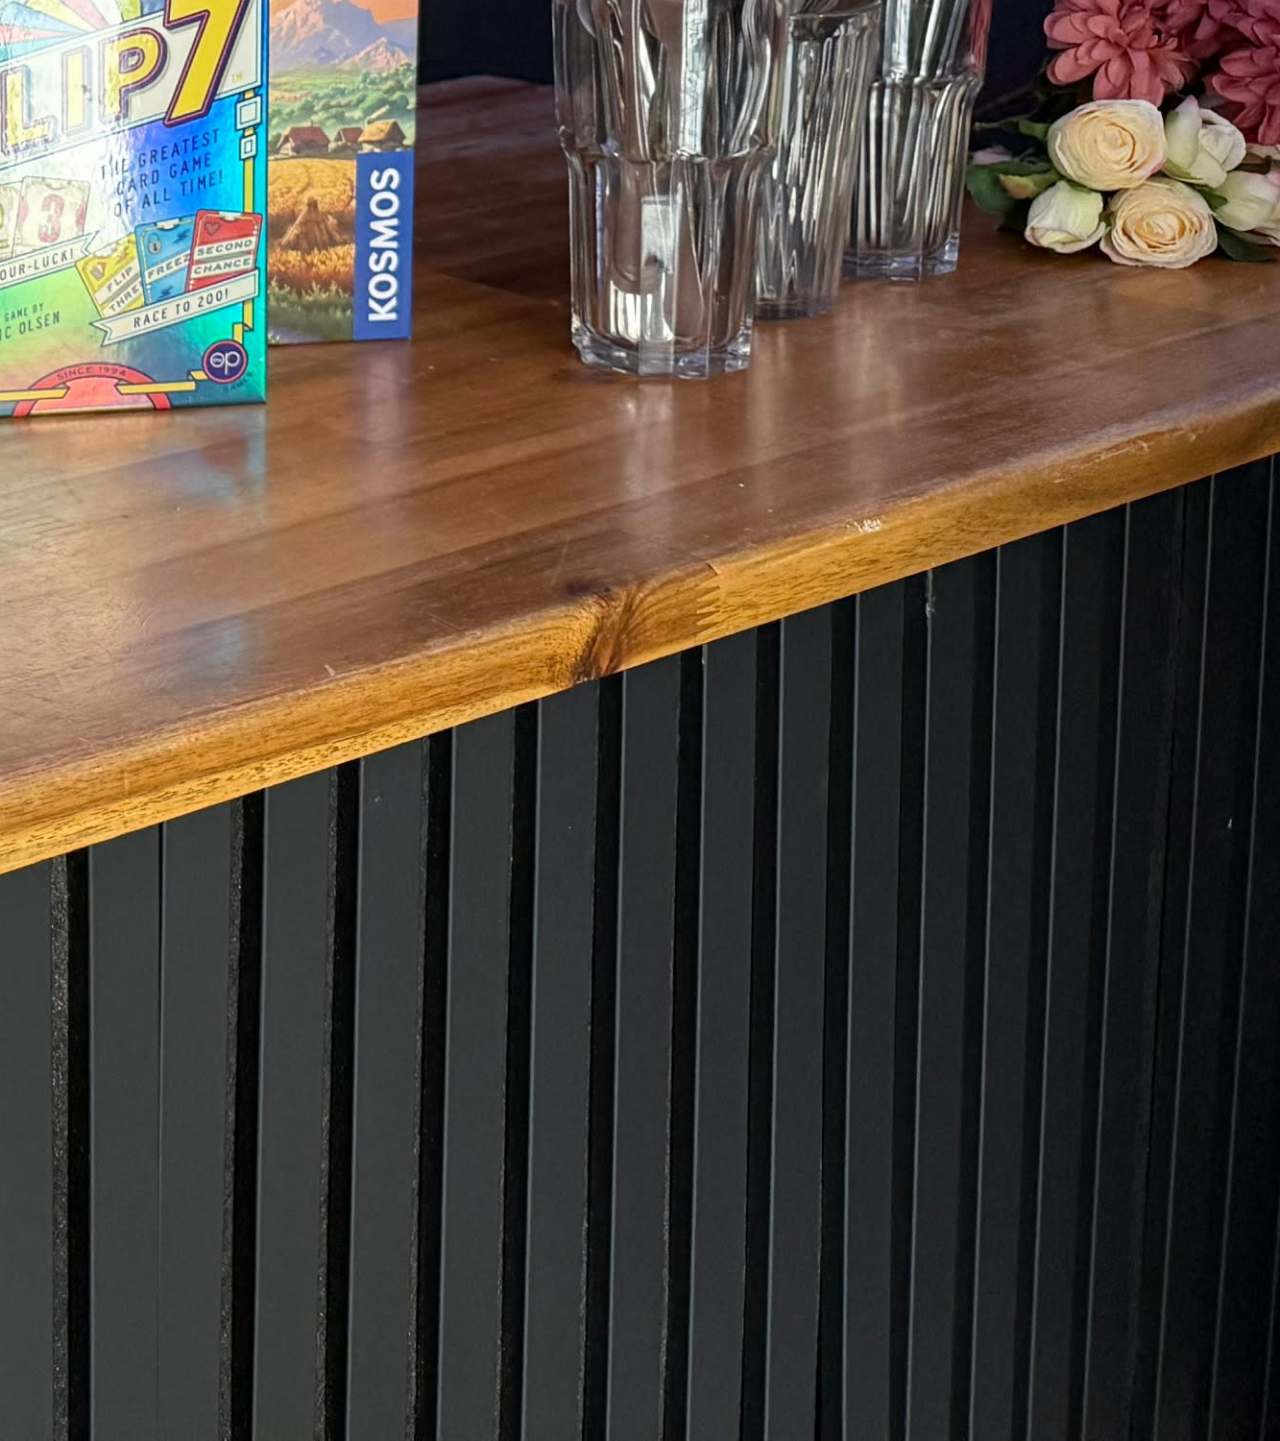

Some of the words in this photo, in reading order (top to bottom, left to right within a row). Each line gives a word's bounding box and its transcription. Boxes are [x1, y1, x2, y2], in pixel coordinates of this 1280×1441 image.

[101, 155, 131, 180] THE
[138, 128, 220, 169] GREATEST
[116, 168, 160, 197] CARD
[169, 152, 213, 179] GAME
[113, 198, 132, 217] OF
[142, 187, 171, 209] ALL
[180, 169, 224, 197] TIME!
[38, 194, 65, 243] 3
[197, 239, 253, 256] SECOND
[368, 168, 400, 321] KOSMOS
[106, 266, 133, 293] FLIP
[193, 256, 251, 276] CHANCE
[18, 311, 61, 336] OLSEN
[133, 307, 169, 329] RACE
[175, 301, 190, 315] TO
[197, 287, 230, 309] 200!
[56, 366, 92, 379] SINCE
